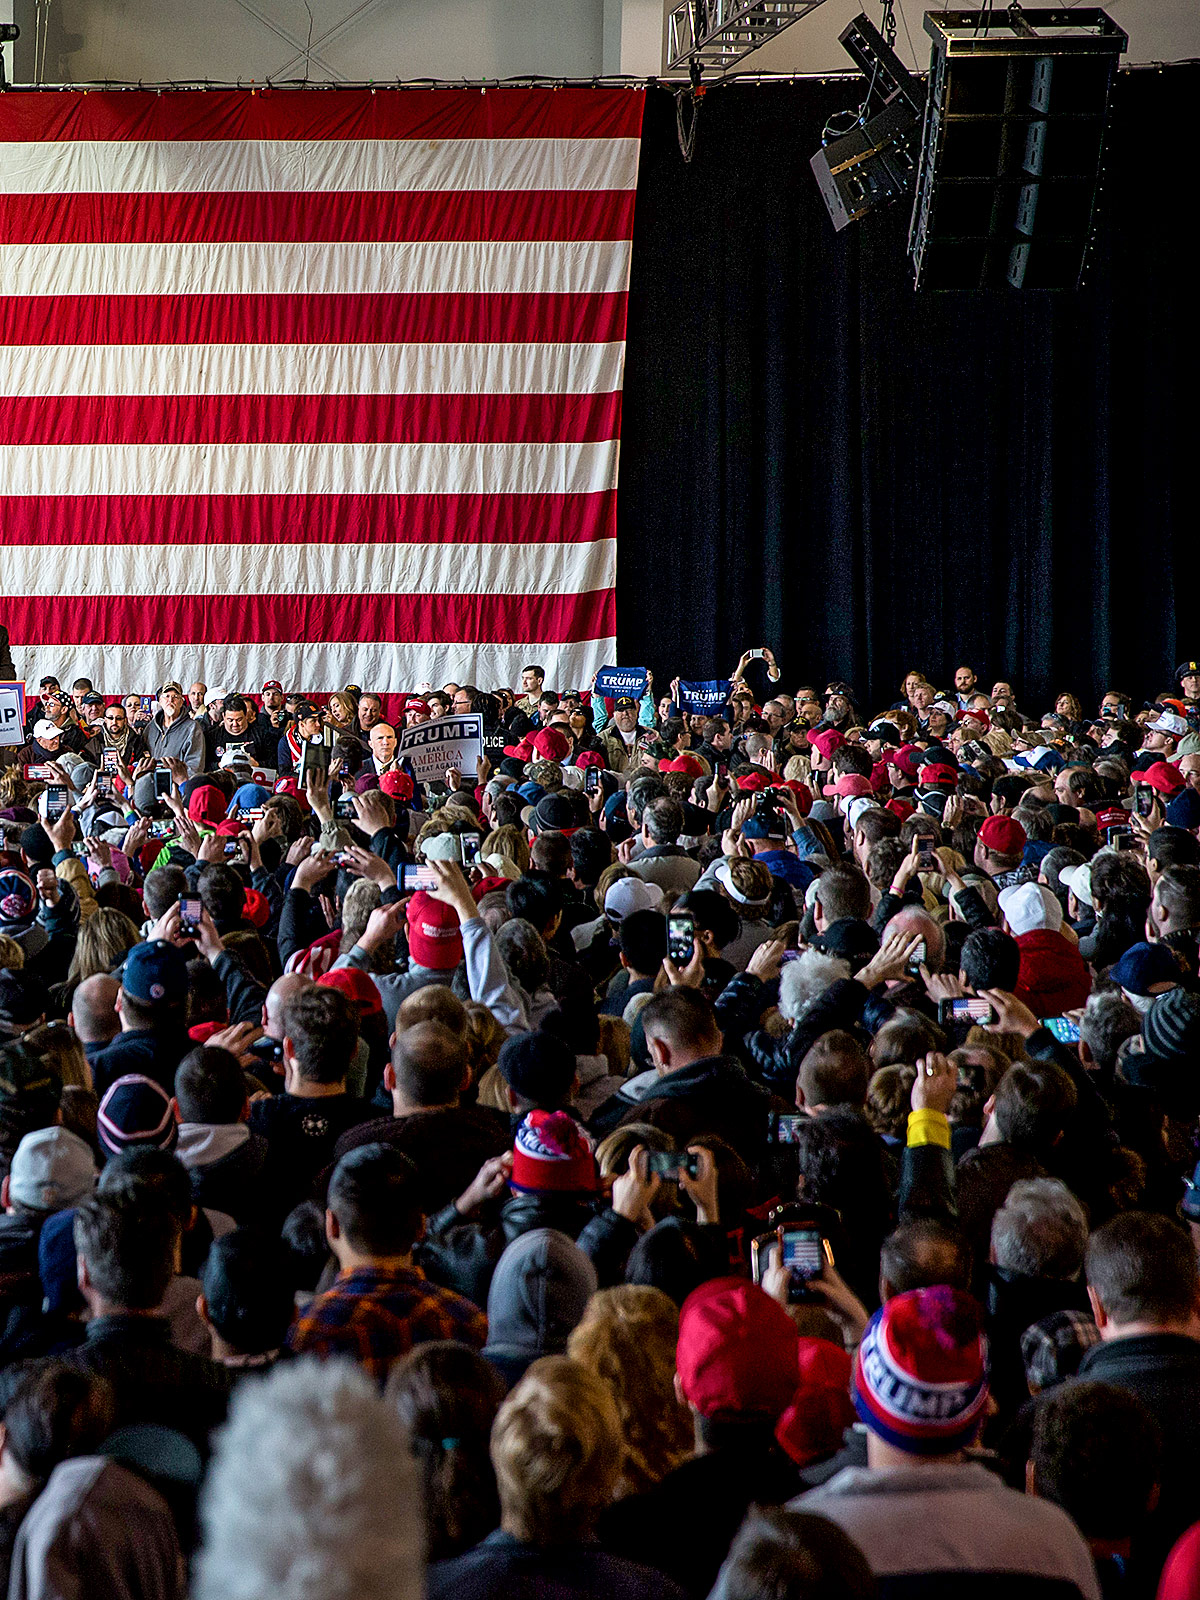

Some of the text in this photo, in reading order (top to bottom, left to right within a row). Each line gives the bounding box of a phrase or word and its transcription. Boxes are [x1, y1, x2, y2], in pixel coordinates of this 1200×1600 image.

[602, 676, 643, 687] TRUMP
[684, 690, 727, 701] TRUMP
[404, 723, 478, 748] TRUMP
[425, 744, 445, 753] MAKE
[412, 750, 463, 766] AMERICA
[860, 1334, 966, 1418] TRUMP
